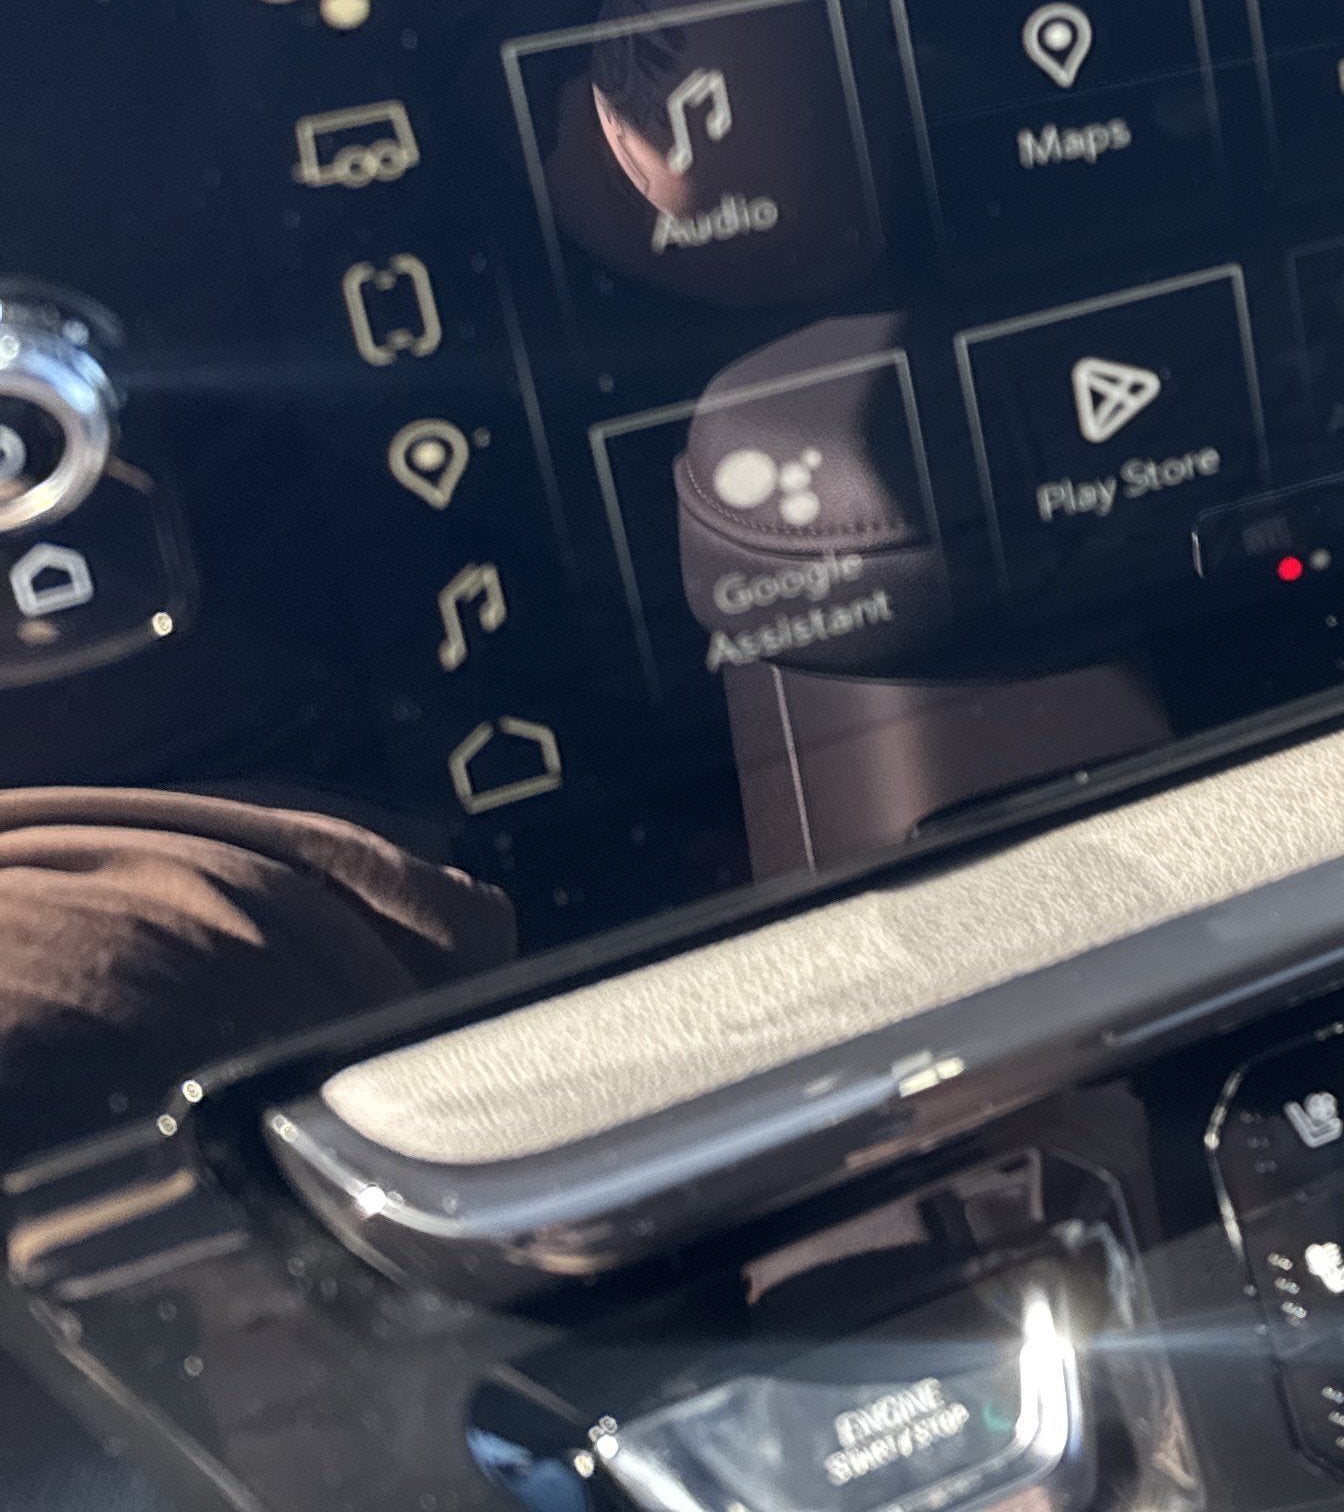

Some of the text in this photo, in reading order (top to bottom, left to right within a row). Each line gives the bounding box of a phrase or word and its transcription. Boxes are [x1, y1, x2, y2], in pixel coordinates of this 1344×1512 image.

[1016, 118, 1132, 169] Maps
[651, 193, 780, 254] Audio
[1036, 446, 1221, 522] Play Store
[714, 549, 865, 615] Google
[706, 590, 894, 673] Assistant
